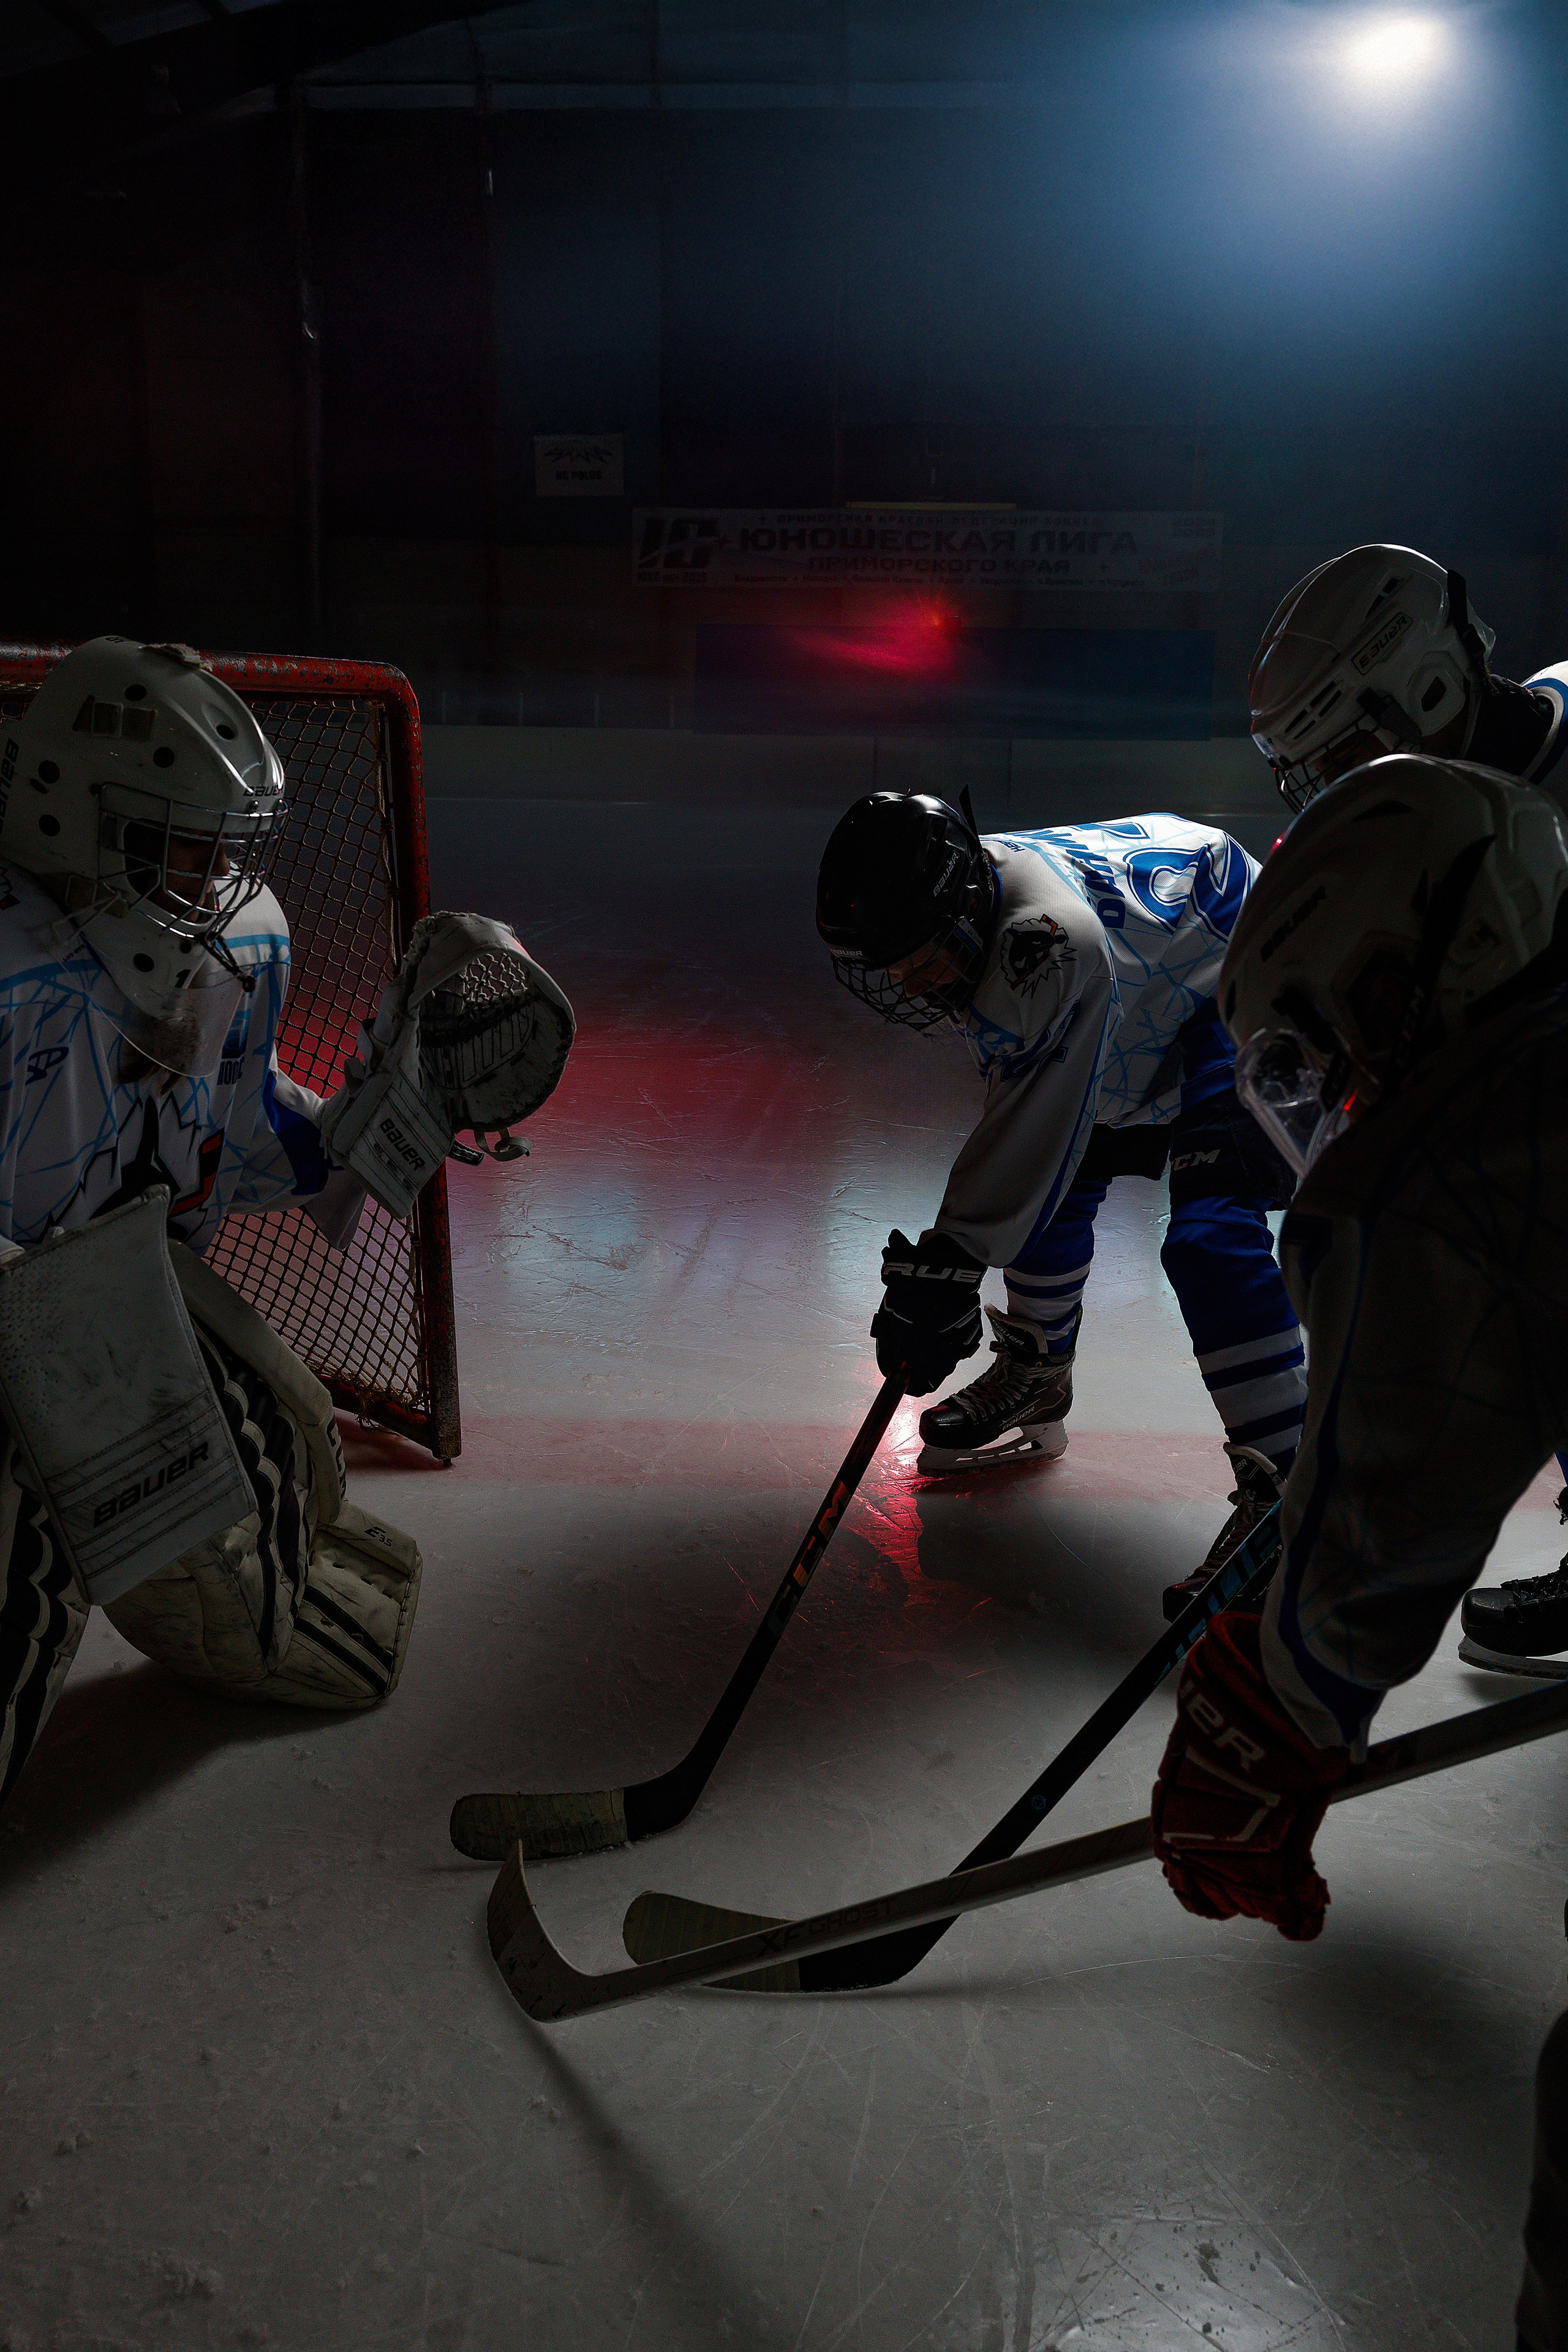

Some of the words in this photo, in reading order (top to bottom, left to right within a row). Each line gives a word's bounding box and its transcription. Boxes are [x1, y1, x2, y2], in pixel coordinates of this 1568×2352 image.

[740, 527, 1017, 552] ЮНОШЕСКАЯ
[1029, 530, 1138, 554] ЛИГА
[807, 556, 997, 573] ПРИМОРСКОГО
[1005, 558, 1071, 573] КРАЯ
[175, 969, 191, 988] 1
[380, 1118, 426, 1172] BAUER
[1171, 1149, 1221, 1172] CM
[882, 1262, 982, 1283] RUE
[93, 1441, 209, 1528] BAUER
[766, 1480, 852, 1639] CCM
[758, 1924, 804, 1958] XF
[809, 1896, 897, 1935] GHOST
